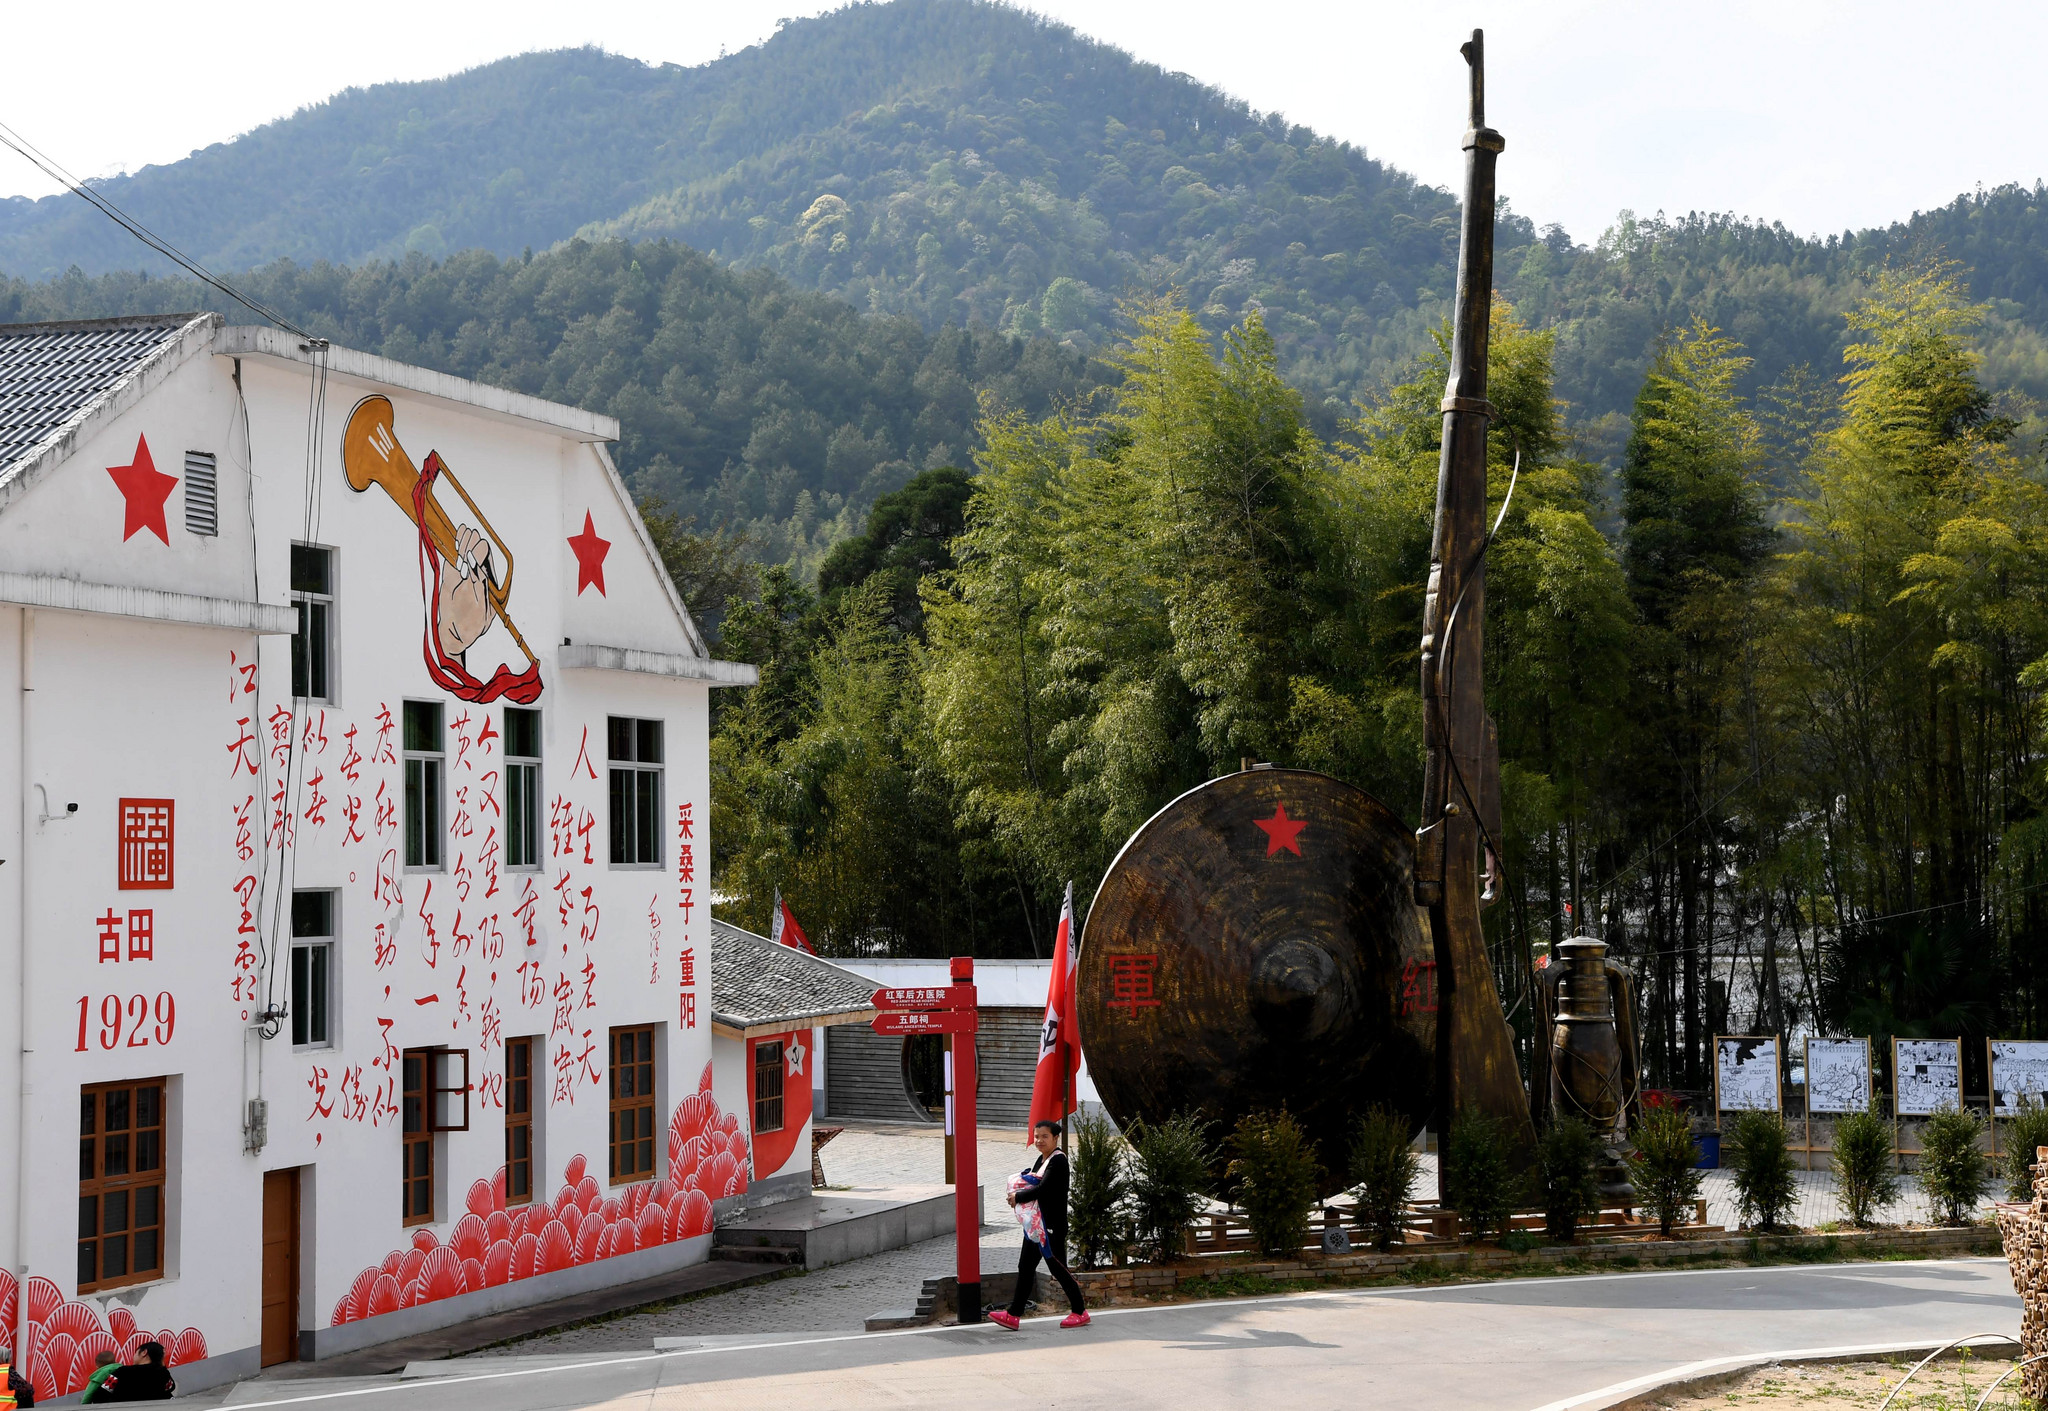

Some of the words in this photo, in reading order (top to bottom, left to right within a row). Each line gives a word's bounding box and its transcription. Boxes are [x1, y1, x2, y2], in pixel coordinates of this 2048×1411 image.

[96, 907, 153, 964] 古田
[885, 989, 946, 1000] 红军后方医院
[1107, 954, 1161, 1019] 軍
[74, 991, 176, 1053] 1929
[899, 1014, 929, 1024] 五郎祠
